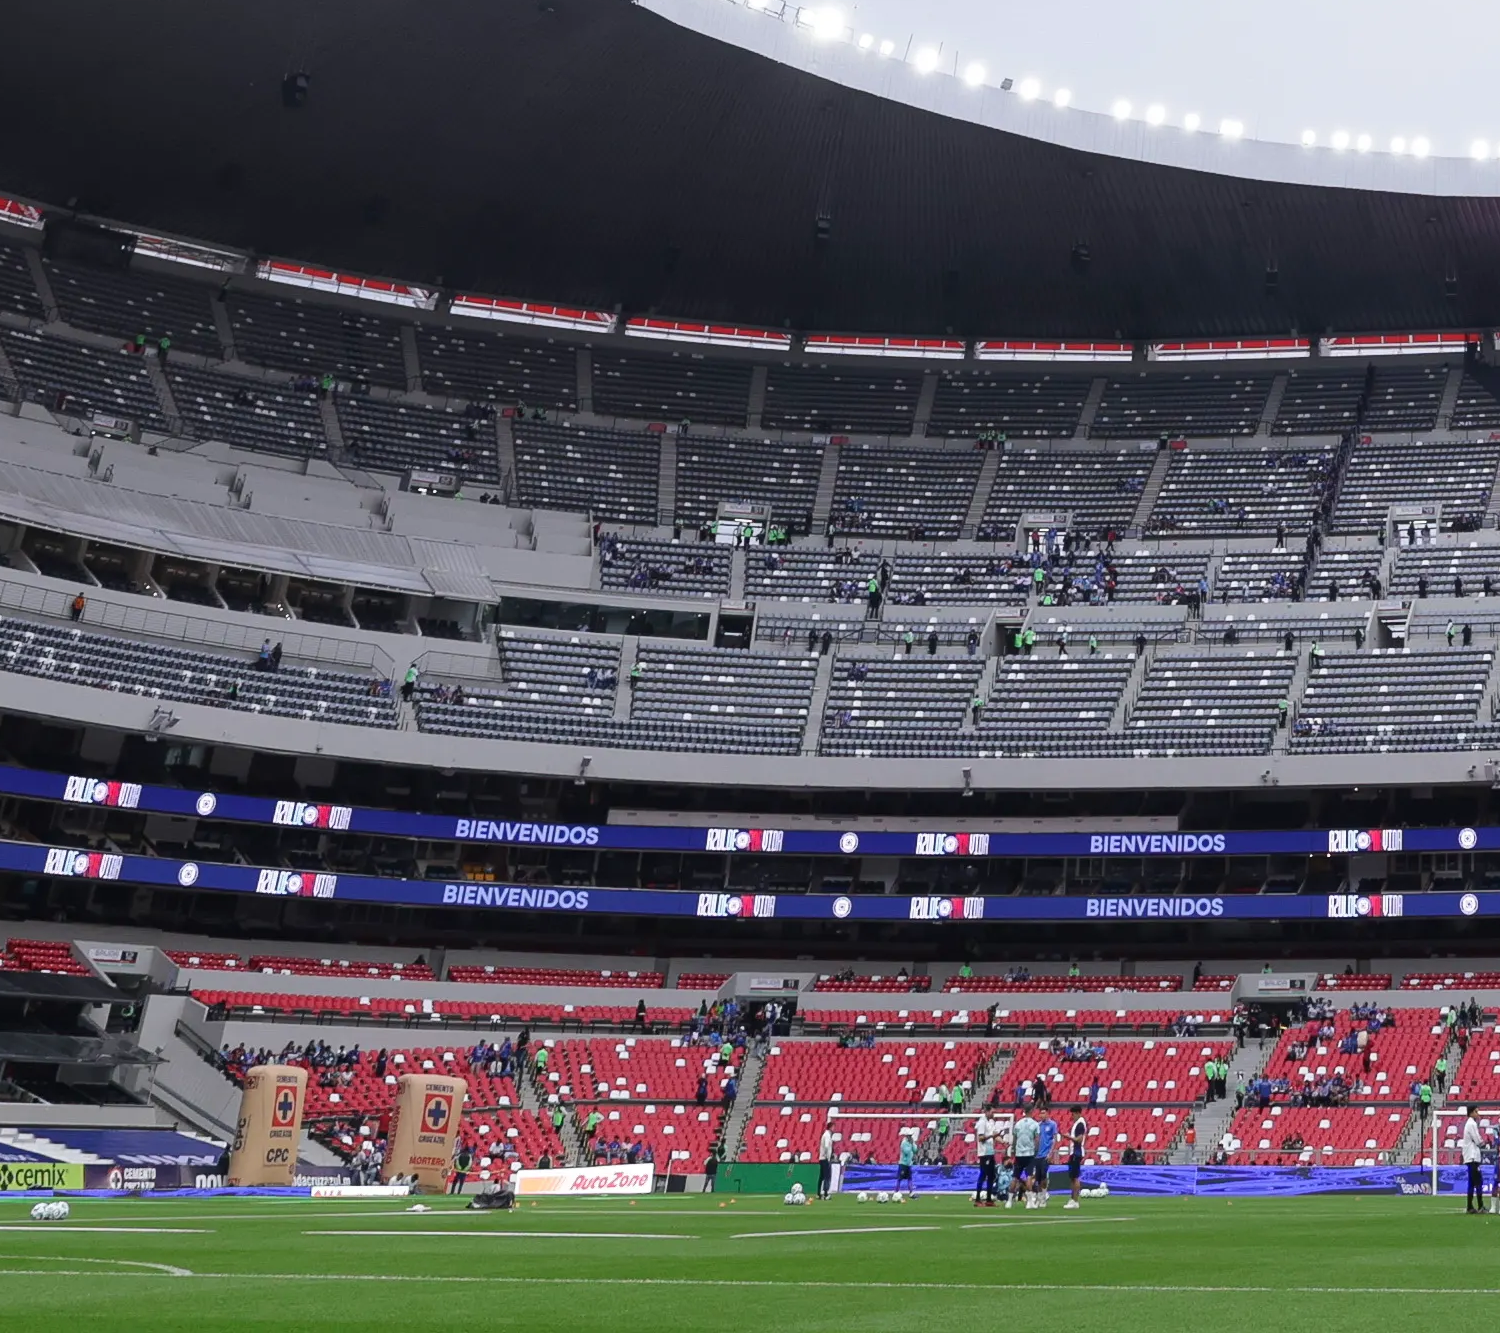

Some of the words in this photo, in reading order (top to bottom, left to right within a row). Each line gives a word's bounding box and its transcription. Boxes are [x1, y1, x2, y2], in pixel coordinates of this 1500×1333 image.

[455, 819, 599, 845] BIENVENIDOS
[1090, 833, 1226, 853] BIENVENIDOS
[442, 884, 589, 910] BIENVENIDOS
[1086, 897, 1224, 917] BIENVENIDOS
[425, 1083, 454, 1093] CEMENTO
[233, 1117, 247, 1151] CPC
[266, 1148, 290, 1163] CPC
[408, 1156, 446, 1167] MORTERO
[15, 1164, 66, 1187] cemix
[123, 1167, 157, 1180] CEMENTO
[571, 1171, 649, 1191] AutoZone
